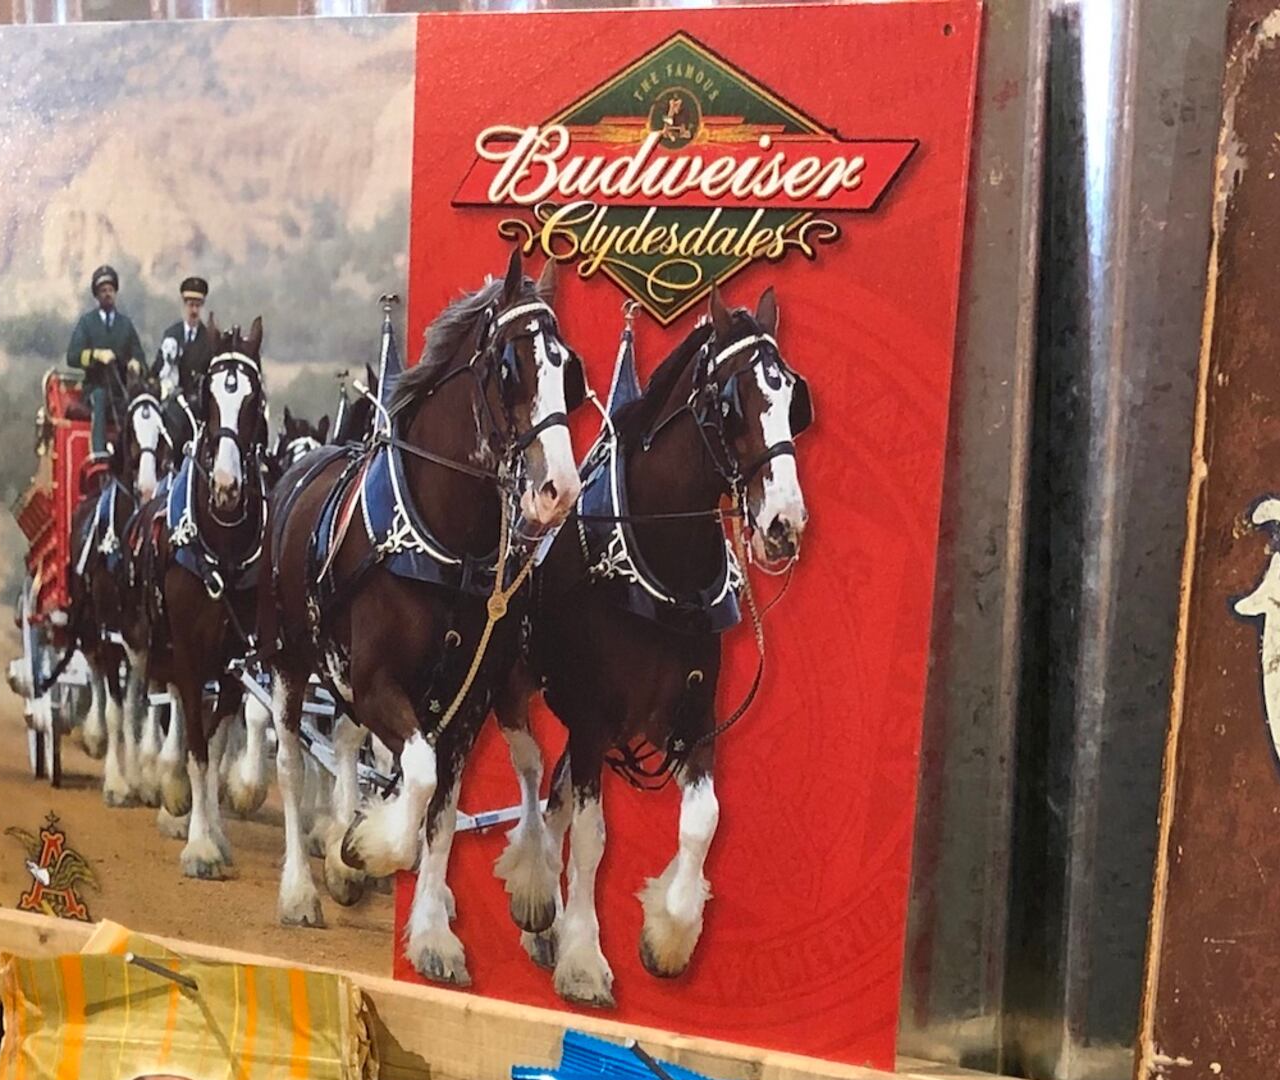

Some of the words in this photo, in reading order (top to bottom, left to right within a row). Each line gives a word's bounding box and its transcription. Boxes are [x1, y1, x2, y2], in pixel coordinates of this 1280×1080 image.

[633, 72, 660, 103] THE
[666, 63, 720, 101] FAMOUS
[476, 126, 868, 206] Budweiser
[510, 202, 815, 280] Clydesdales
